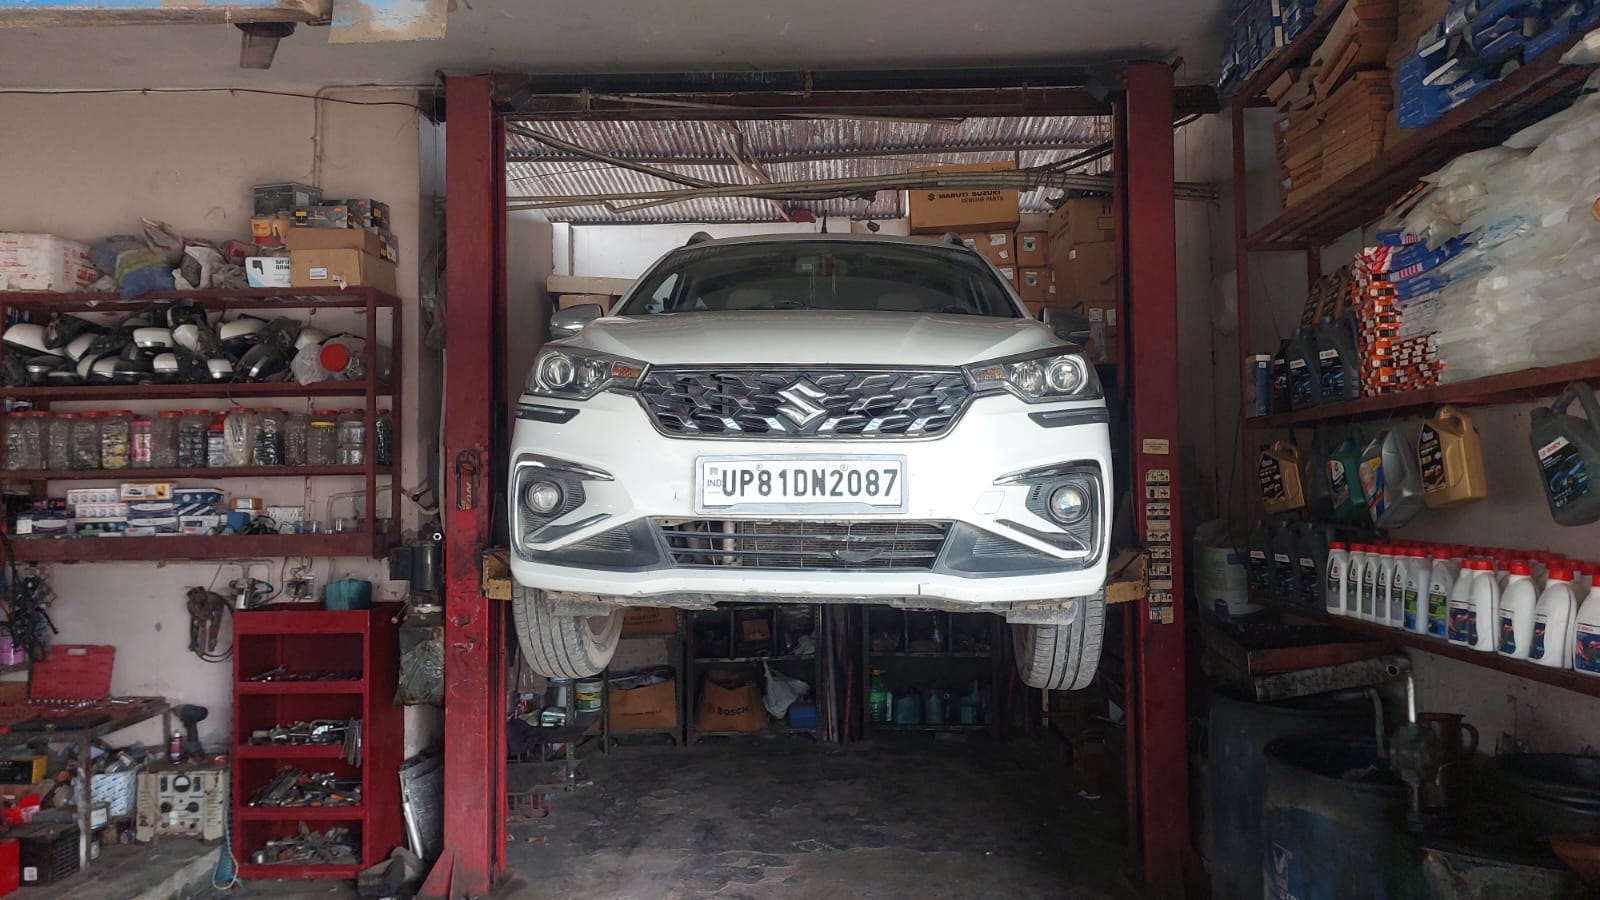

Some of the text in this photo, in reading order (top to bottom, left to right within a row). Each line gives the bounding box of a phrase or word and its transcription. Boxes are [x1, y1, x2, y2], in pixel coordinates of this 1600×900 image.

[938, 191, 969, 199] MARUTI
[707, 468, 898, 497] IND UP81DN2087
[717, 706, 749, 716] BOSCH
